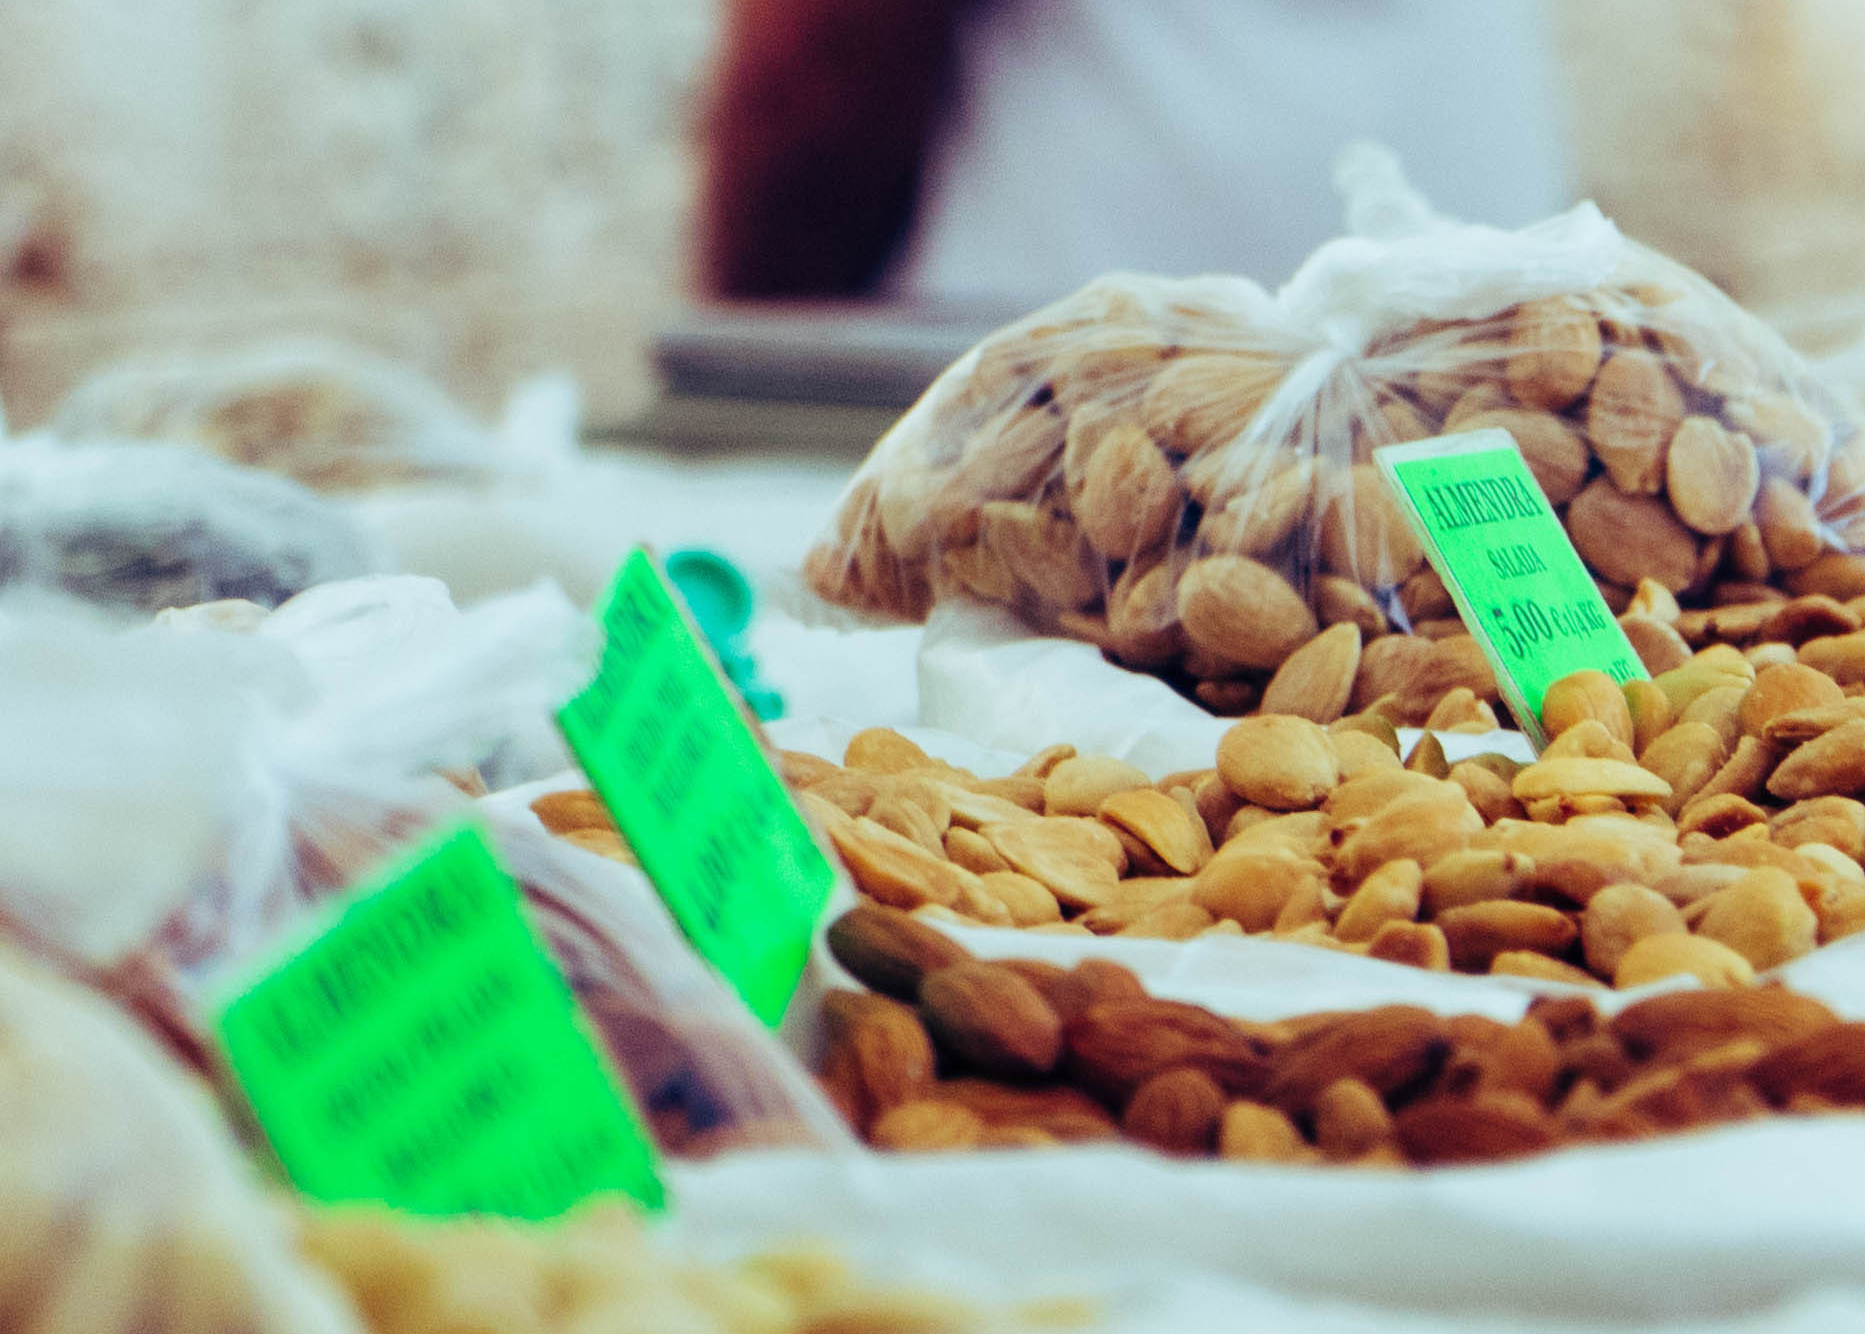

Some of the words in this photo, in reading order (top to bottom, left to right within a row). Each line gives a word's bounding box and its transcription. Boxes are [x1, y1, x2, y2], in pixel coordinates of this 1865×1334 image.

[1422, 475, 1544, 531] ALMENDRA
[1487, 543, 1548, 581] SALADA
[1492, 599, 1554, 660] 5,00
